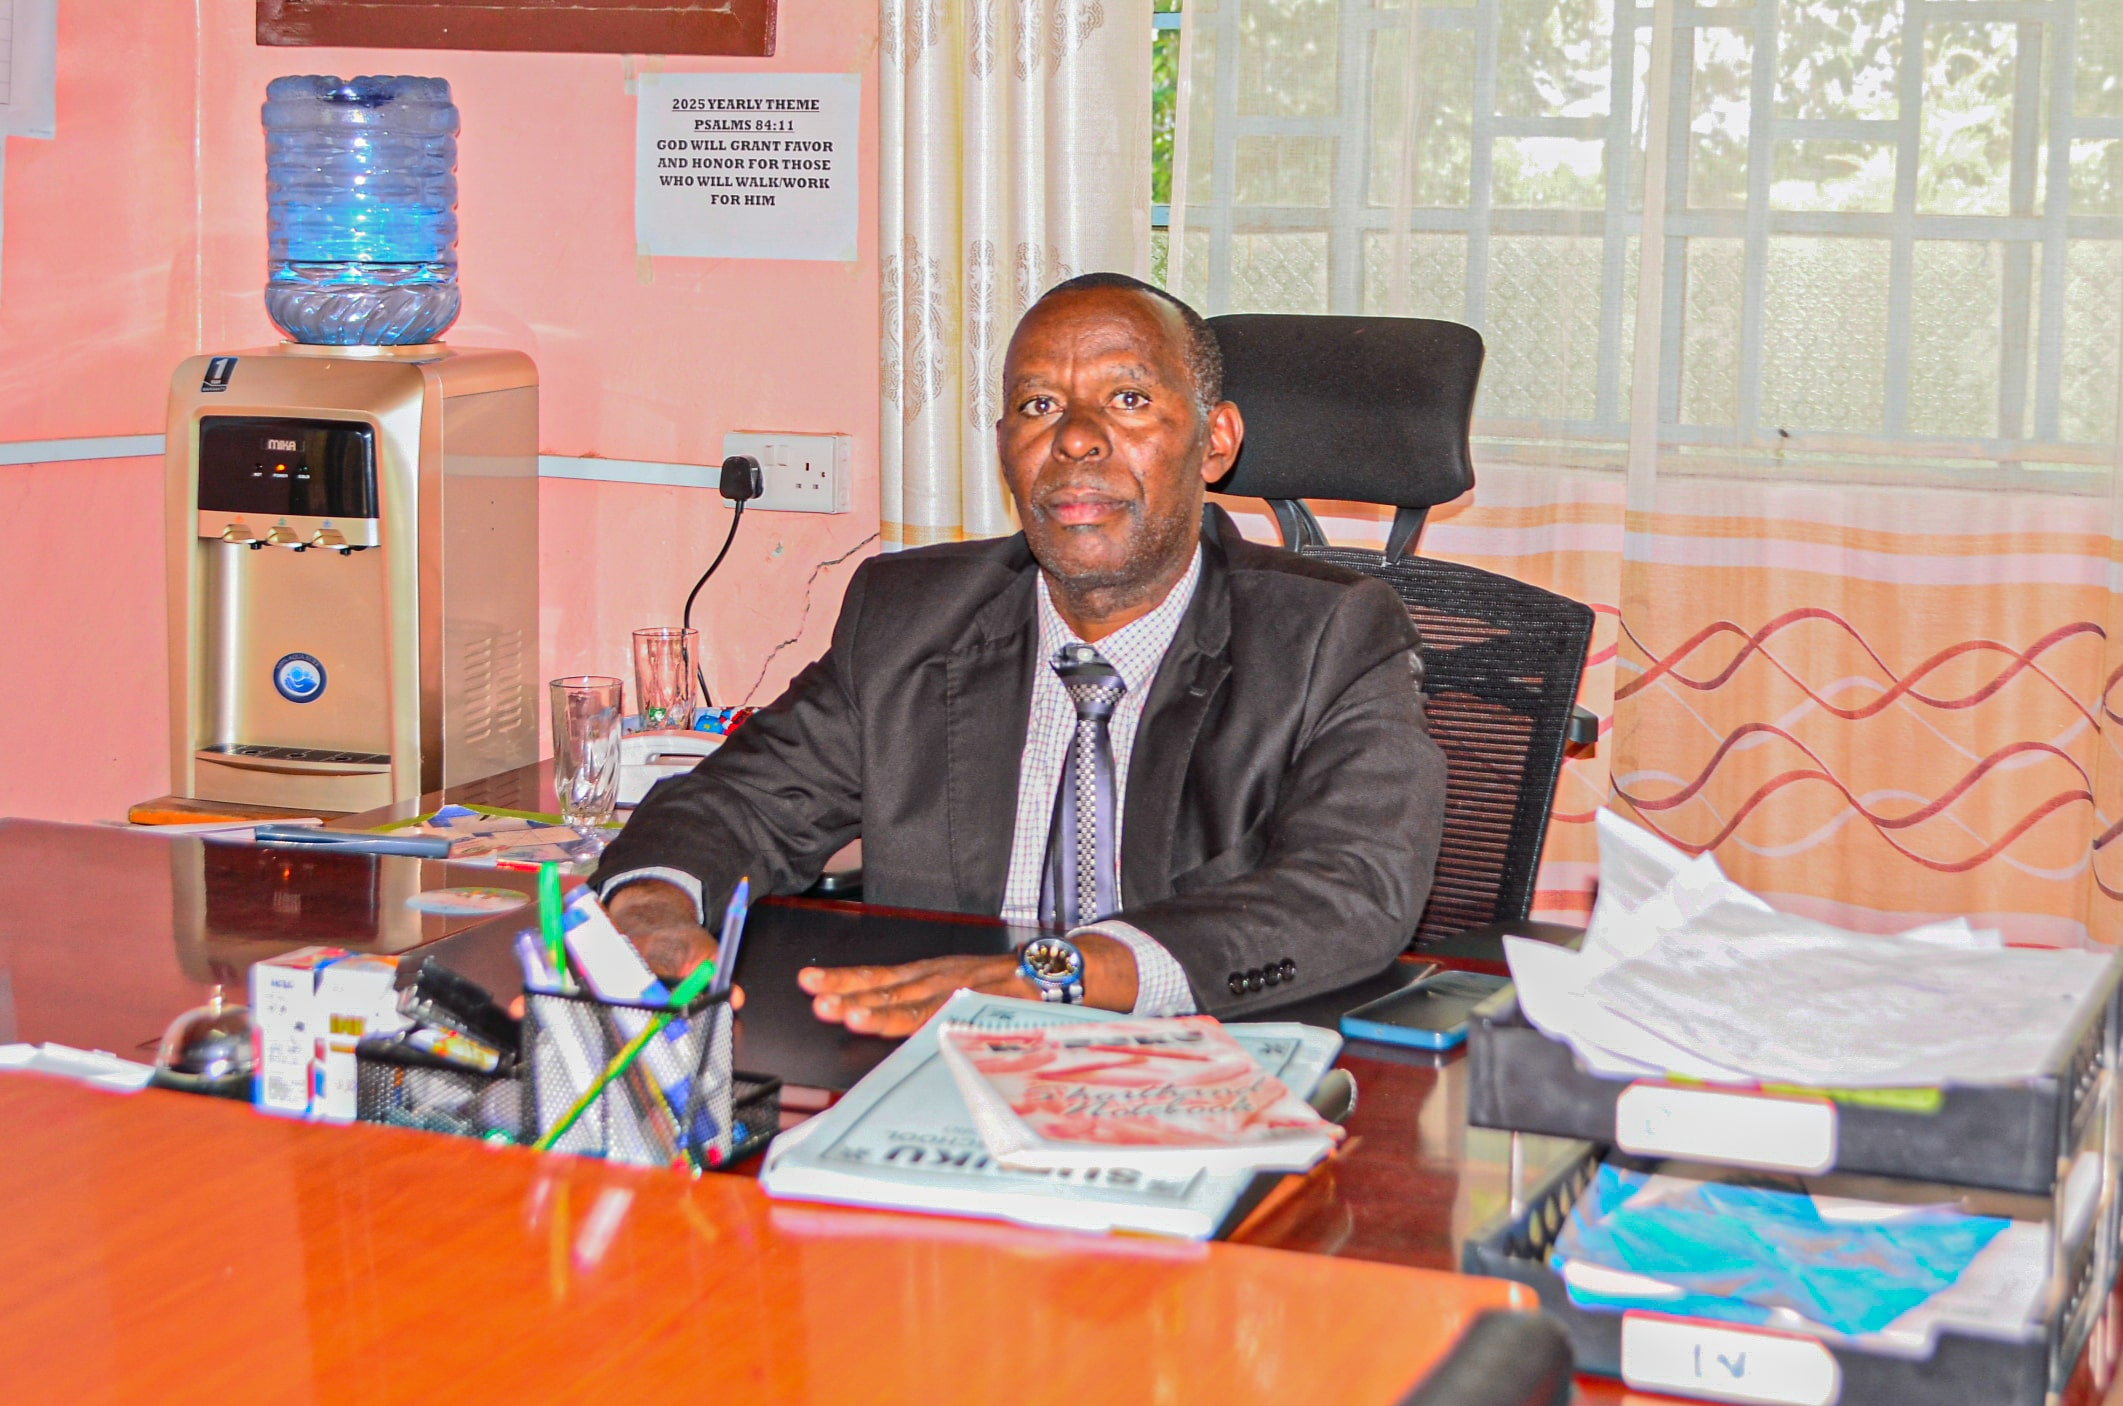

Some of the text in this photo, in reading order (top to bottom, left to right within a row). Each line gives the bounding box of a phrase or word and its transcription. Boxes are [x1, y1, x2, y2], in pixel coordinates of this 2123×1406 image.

[672, 98, 820, 111] 2025 YEARLY THEME
[694, 119, 795, 132] PSALMS 84:11
[656, 139, 834, 153] GOD WILL GRANT FAVOR
[657, 157, 832, 171] AND HONOR FOR THOSE
[659, 175, 831, 189] WHO WILL WALK/WORK
[710, 194, 776, 207] FOR HIM
[214, 358, 229, 379] 1
[267, 438, 297, 452] MIKA
